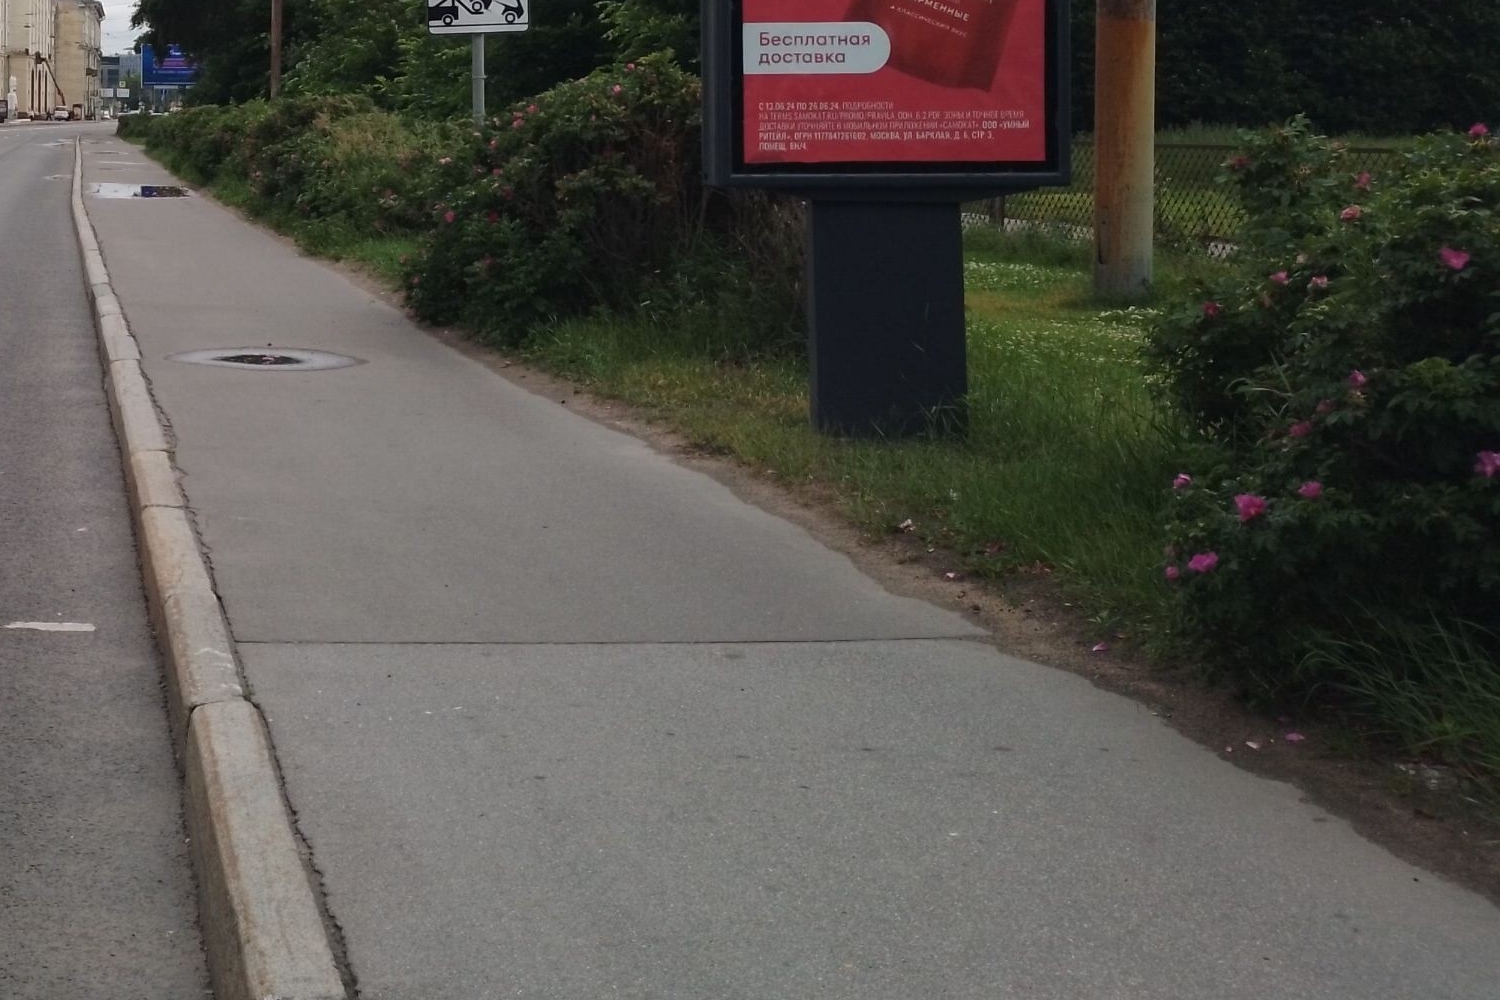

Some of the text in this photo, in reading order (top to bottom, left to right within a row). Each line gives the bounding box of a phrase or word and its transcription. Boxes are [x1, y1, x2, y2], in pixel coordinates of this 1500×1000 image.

[759, 31, 871, 46] Бесплатная
[759, 52, 846, 66] доставка
[796, 102, 807, 111] ПО
[982, 120, 998, 129] ООО
[794, 131, 812, 140] ОГРН
